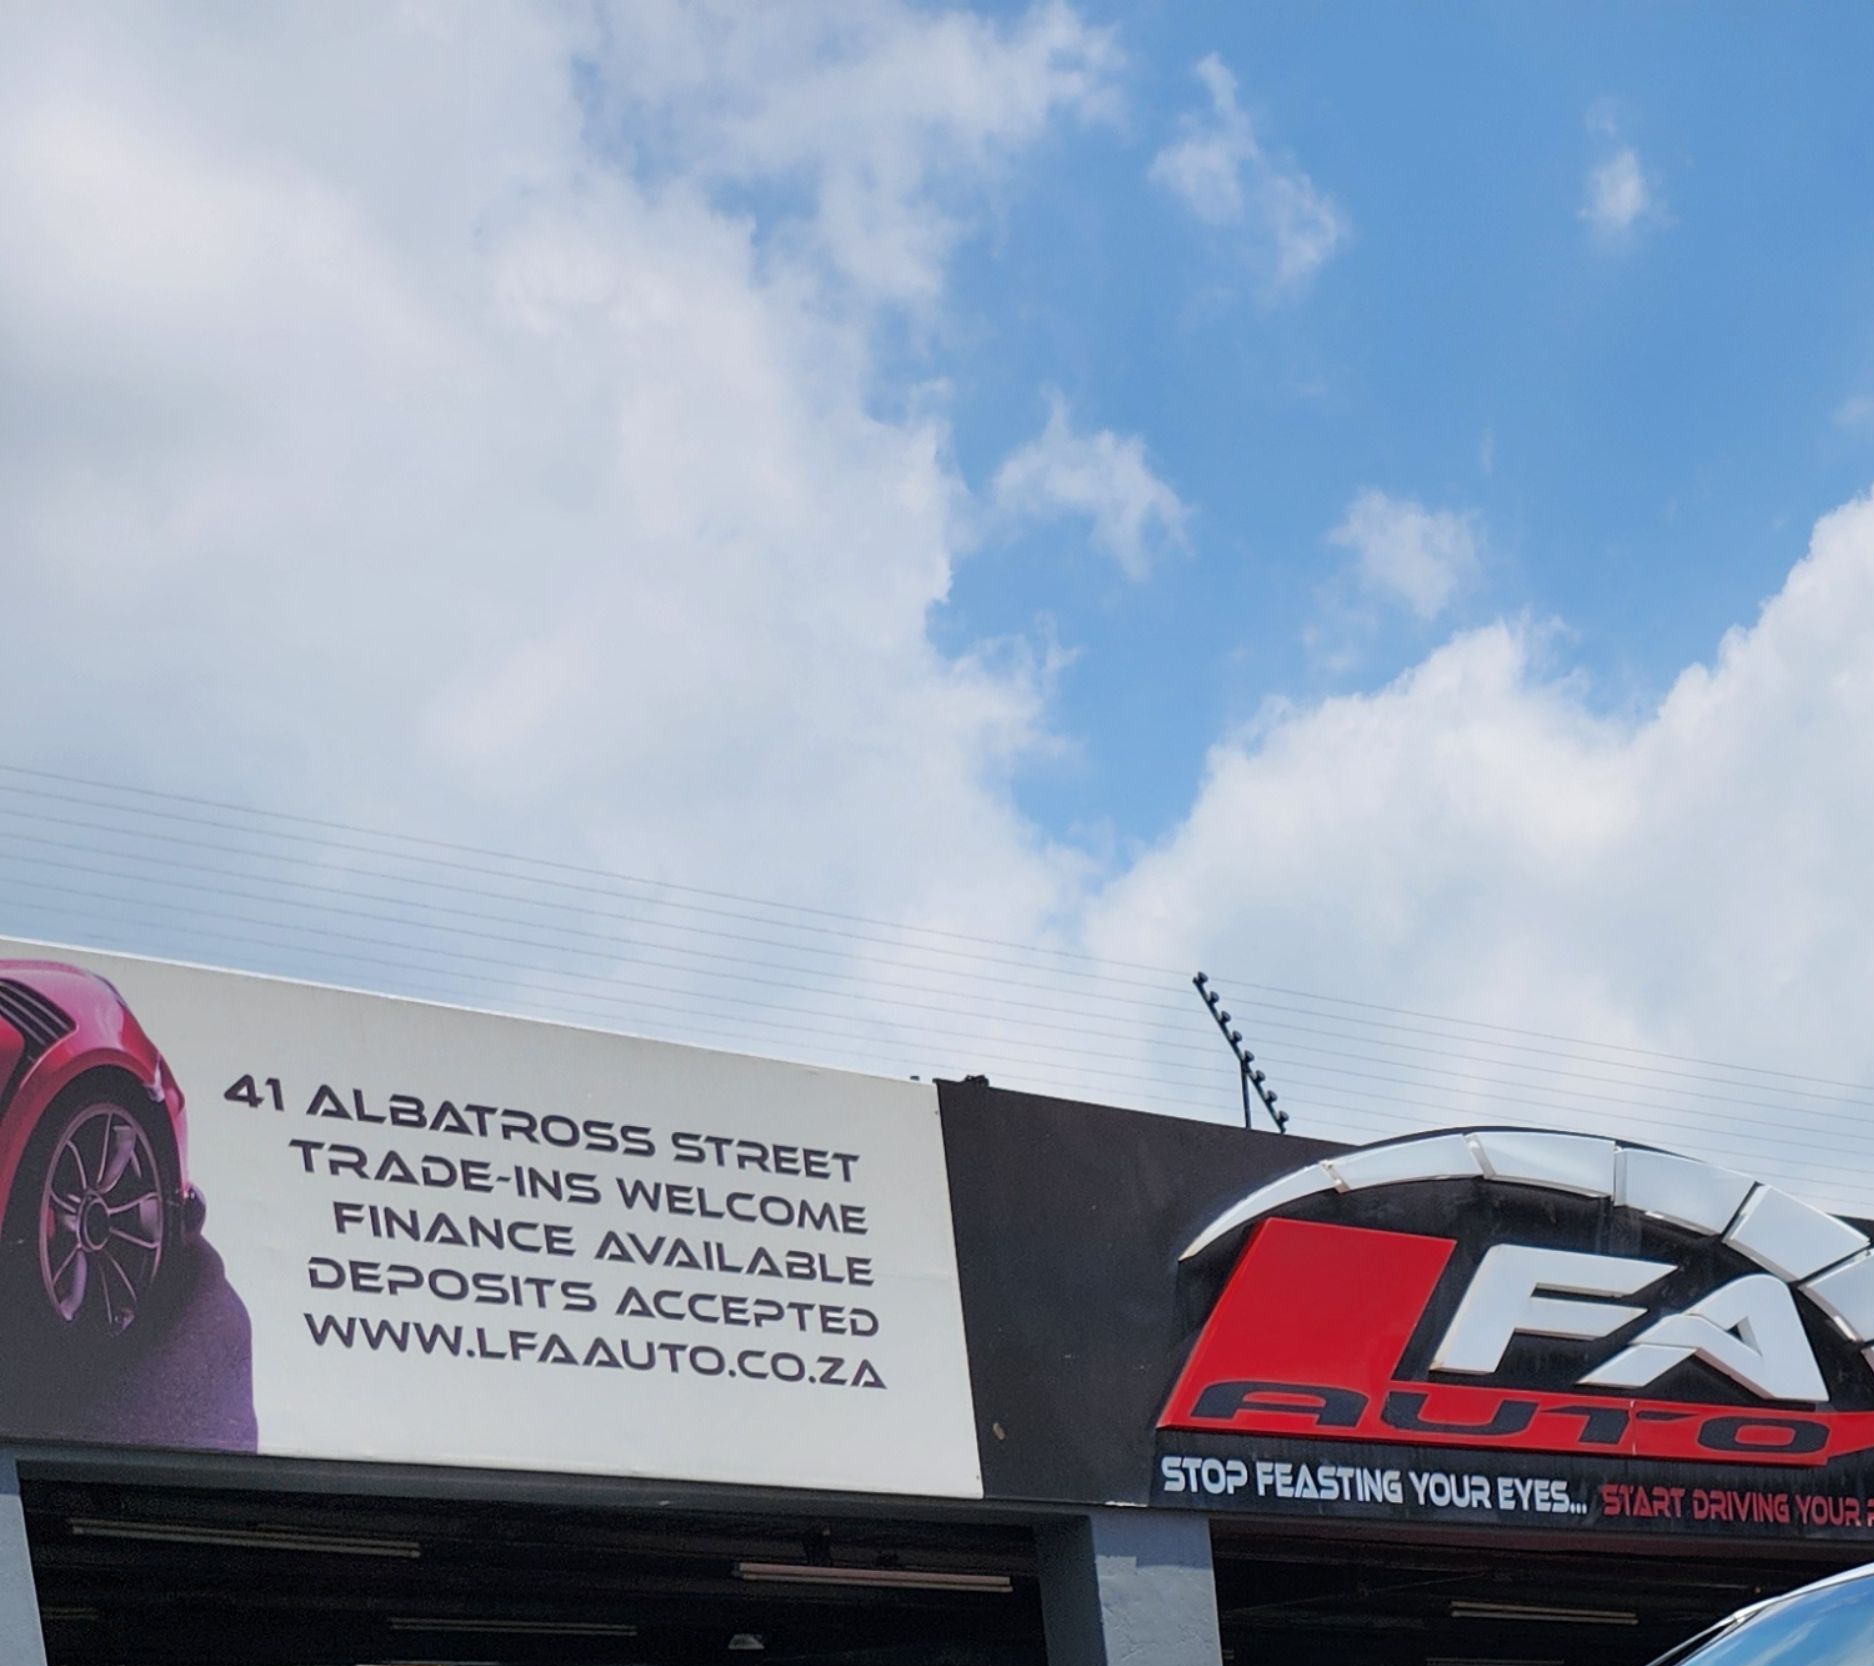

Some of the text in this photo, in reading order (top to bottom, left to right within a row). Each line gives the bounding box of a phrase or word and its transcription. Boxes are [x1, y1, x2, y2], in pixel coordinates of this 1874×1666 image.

[224, 1073, 860, 1183] 41 ALBATROSS STREET
[289, 1140, 869, 1236] TRADE-INS WELCOME
[333, 1202, 874, 1288] FINANCE AVAILABLE
[309, 1256, 880, 1338] DEPOSITS ACCEPTED
[304, 1312, 888, 1391] WWW.LFAAUTO.CO.ZA
[1190, 1381, 1832, 1456] AUTO
[1161, 1456, 1248, 1495] STOP
[1255, 1462, 1403, 1503] FEASTING
[1408, 1471, 1492, 1509] YOUR
[1499, 1477, 1588, 1514] EYES...
[1602, 1484, 1686, 1519] START
[1692, 1489, 1791, 1523] DRIVING
[1796, 1496, 1861, 1528] YOUR
